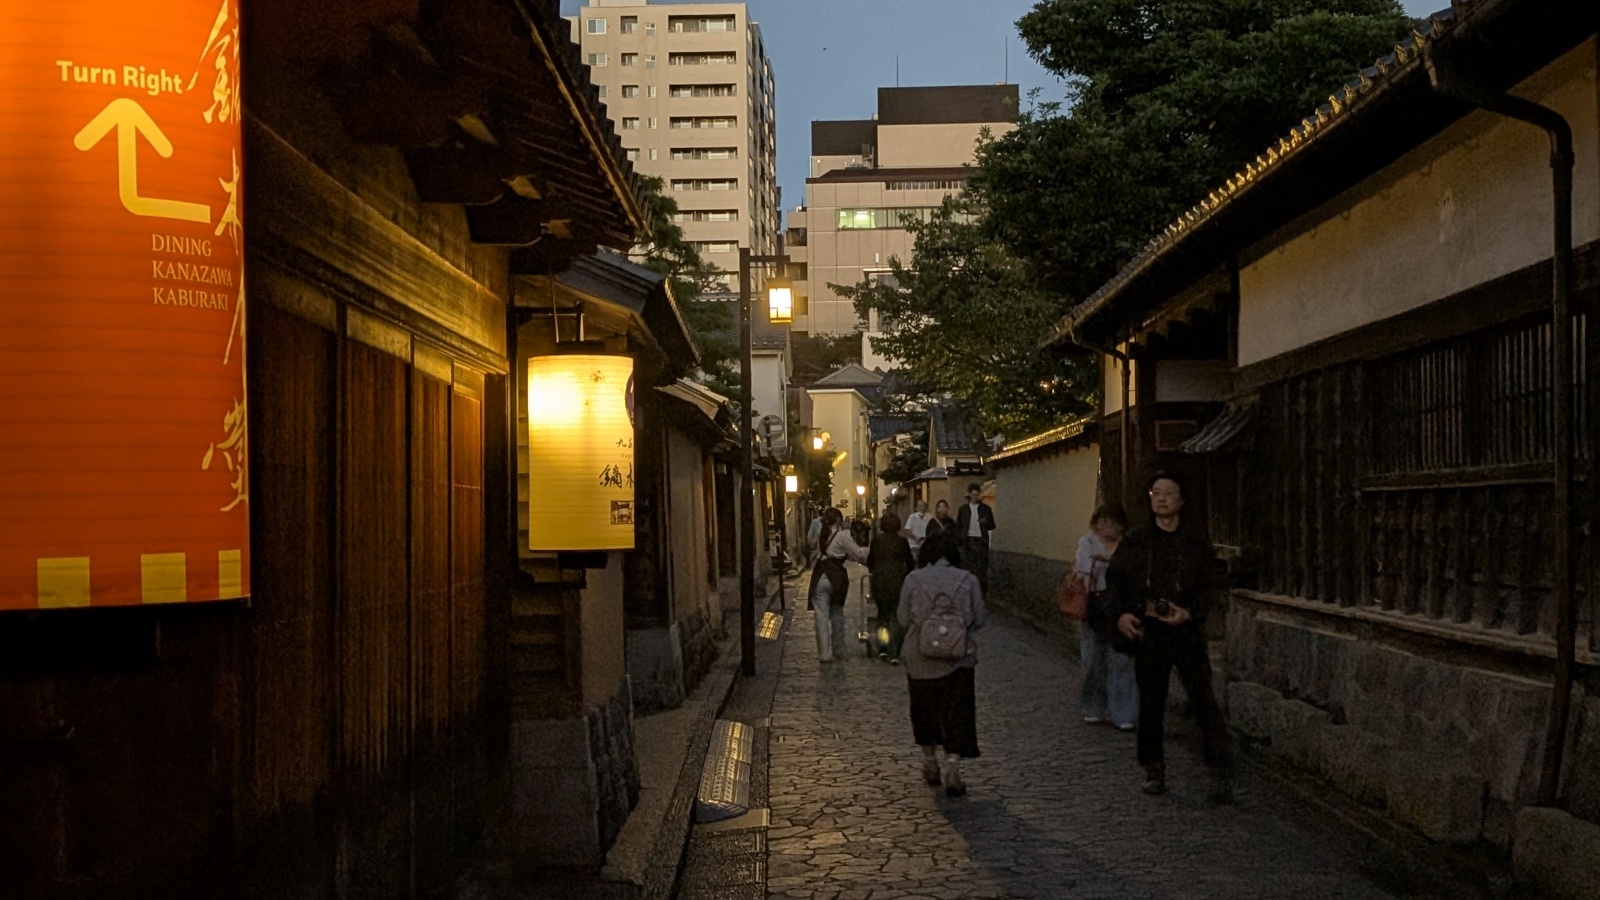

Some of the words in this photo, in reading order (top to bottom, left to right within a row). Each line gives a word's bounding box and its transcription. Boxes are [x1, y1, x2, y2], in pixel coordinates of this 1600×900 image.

[56, 60, 117, 86] Turn
[123, 65, 183, 96] Right
[151, 234, 212, 257] DINING
[151, 260, 233, 287] KANAZAWA
[152, 287, 229, 311] KABURAKI
